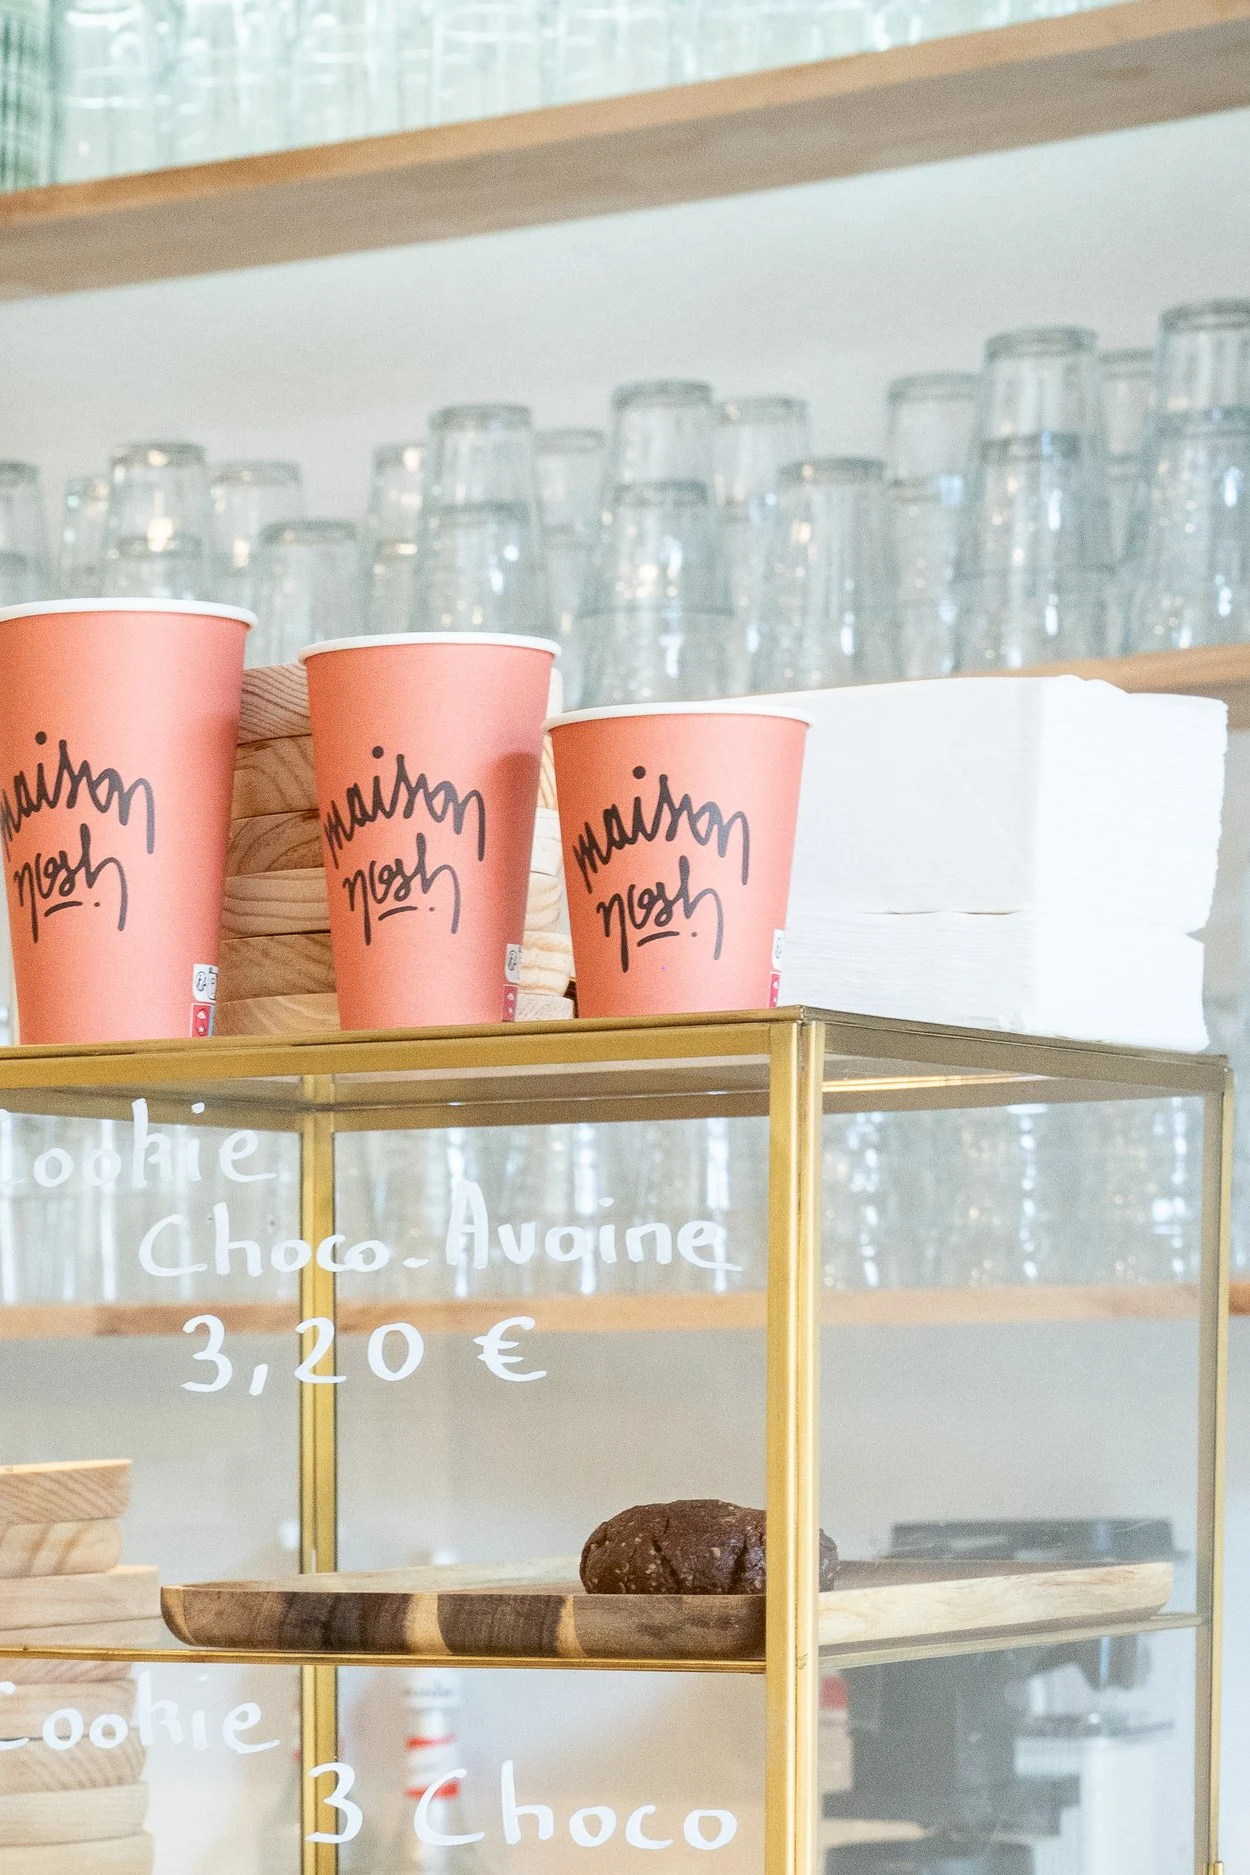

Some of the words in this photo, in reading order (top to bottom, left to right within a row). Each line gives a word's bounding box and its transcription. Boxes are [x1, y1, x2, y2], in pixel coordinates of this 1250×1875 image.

[323, 745, 487, 870] maison
[572, 764, 751, 895] maison
[305, 1761, 364, 1845] 3
[414, 1760, 738, 1851] Choco
